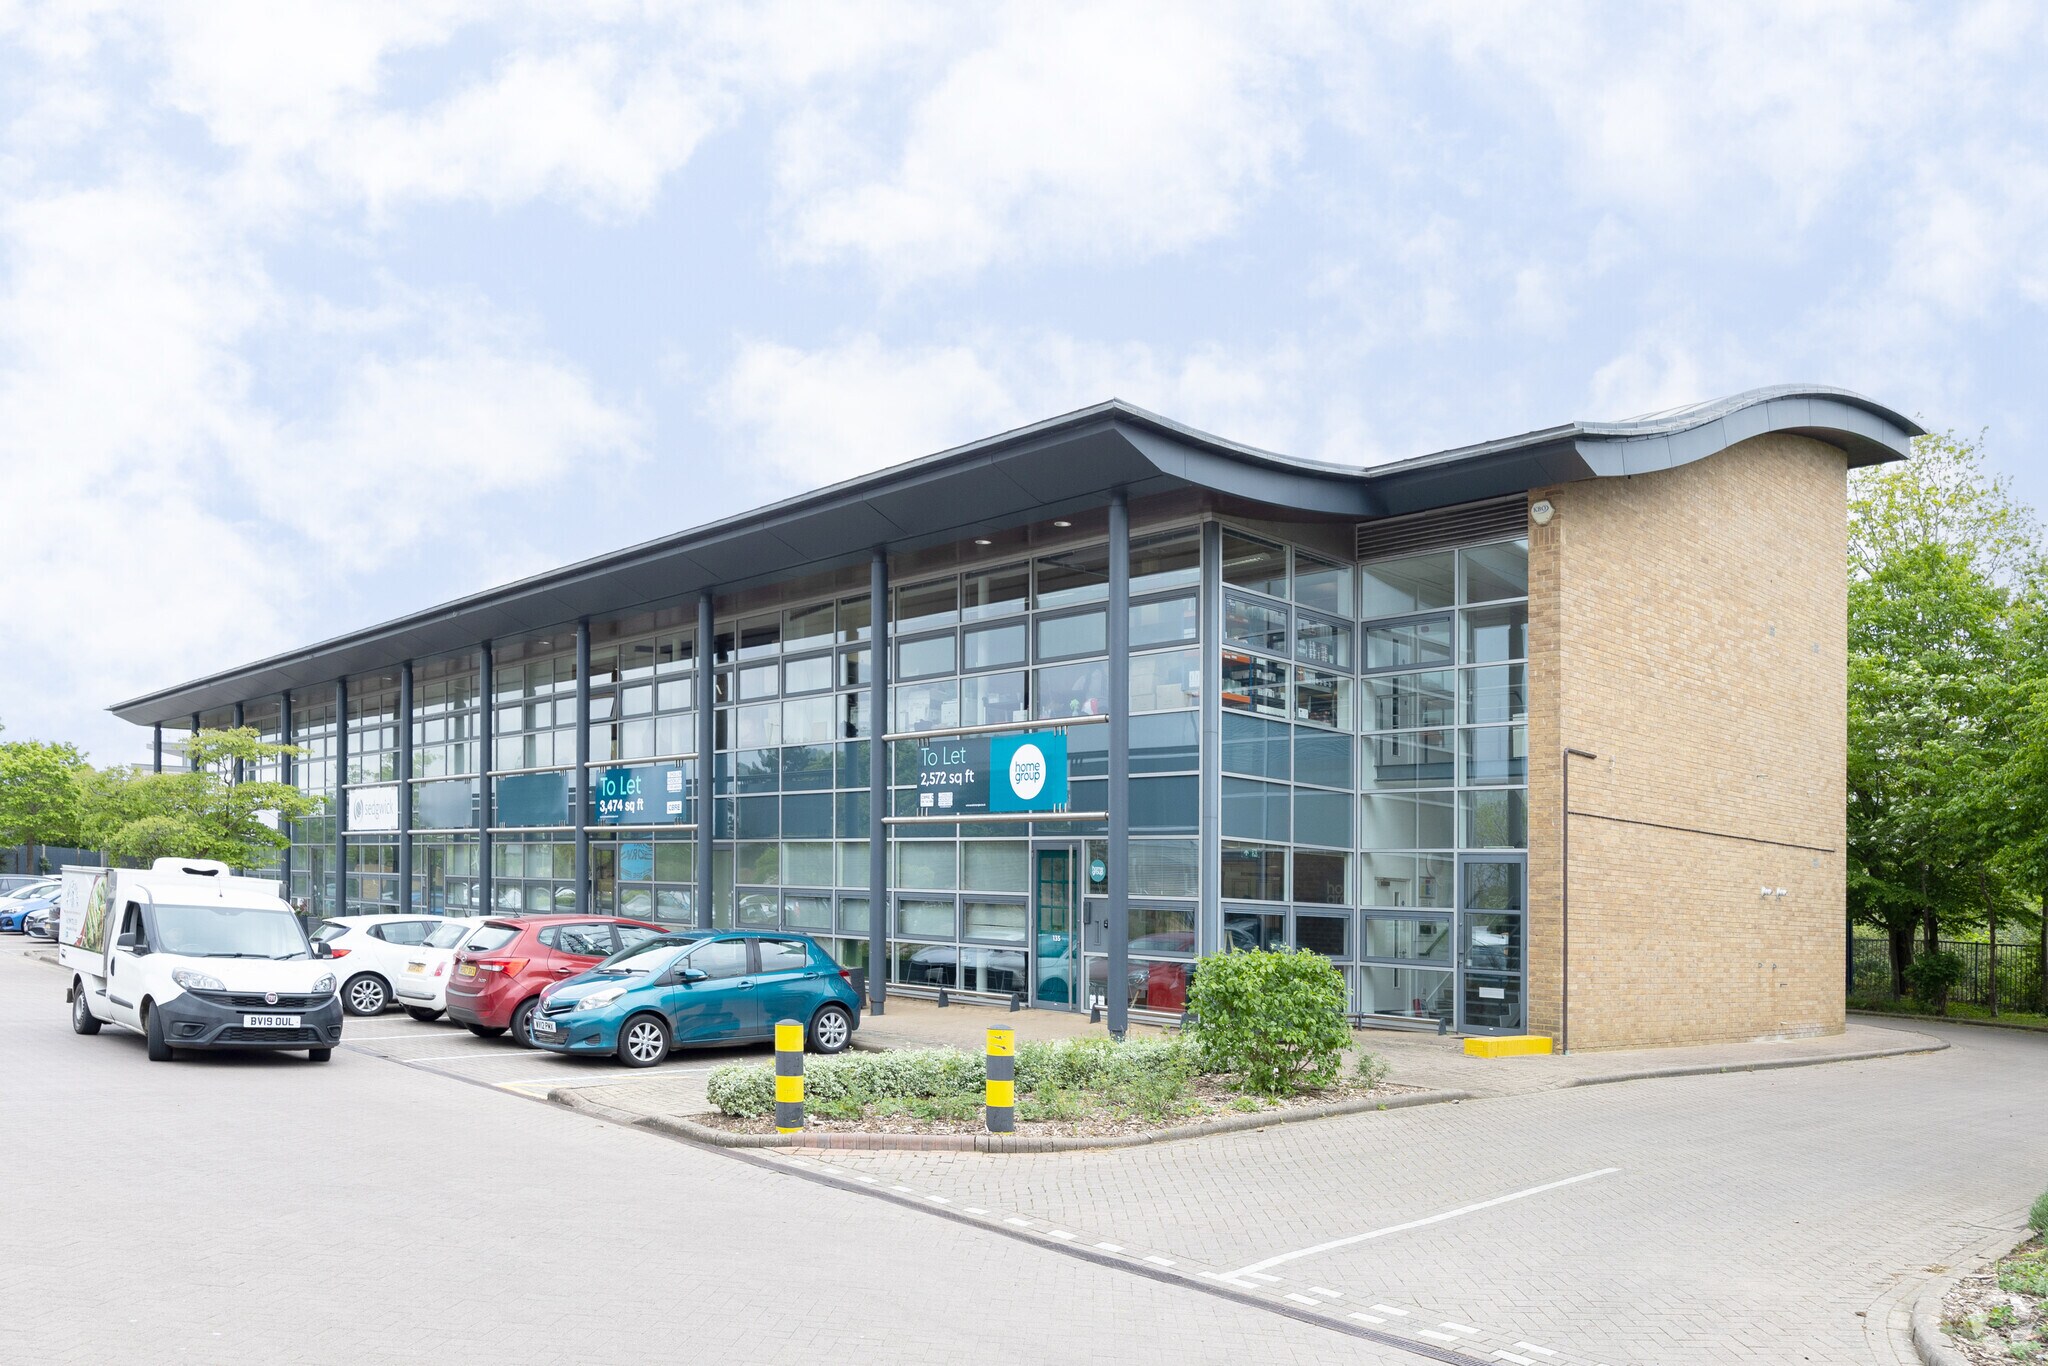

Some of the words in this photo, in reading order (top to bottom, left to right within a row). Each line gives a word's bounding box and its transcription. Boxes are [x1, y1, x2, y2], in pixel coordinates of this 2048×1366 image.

[921, 747, 938, 766] To
[943, 746, 966, 765] Let
[1015, 760, 1040, 772] home
[600, 777, 616, 796] To
[620, 776, 642, 795] Let
[920, 771, 946, 787] 2,572
[949, 772, 962, 785] sq
[965, 769, 974, 783] ft
[1014, 771, 1040, 784] group
[600, 799, 623, 815] 3,474
[625, 801, 635, 814] sq
[637, 798, 644, 811] ft
[250, 1016, 273, 1026] BV19
[275, 1017, 295, 1026] OUL
